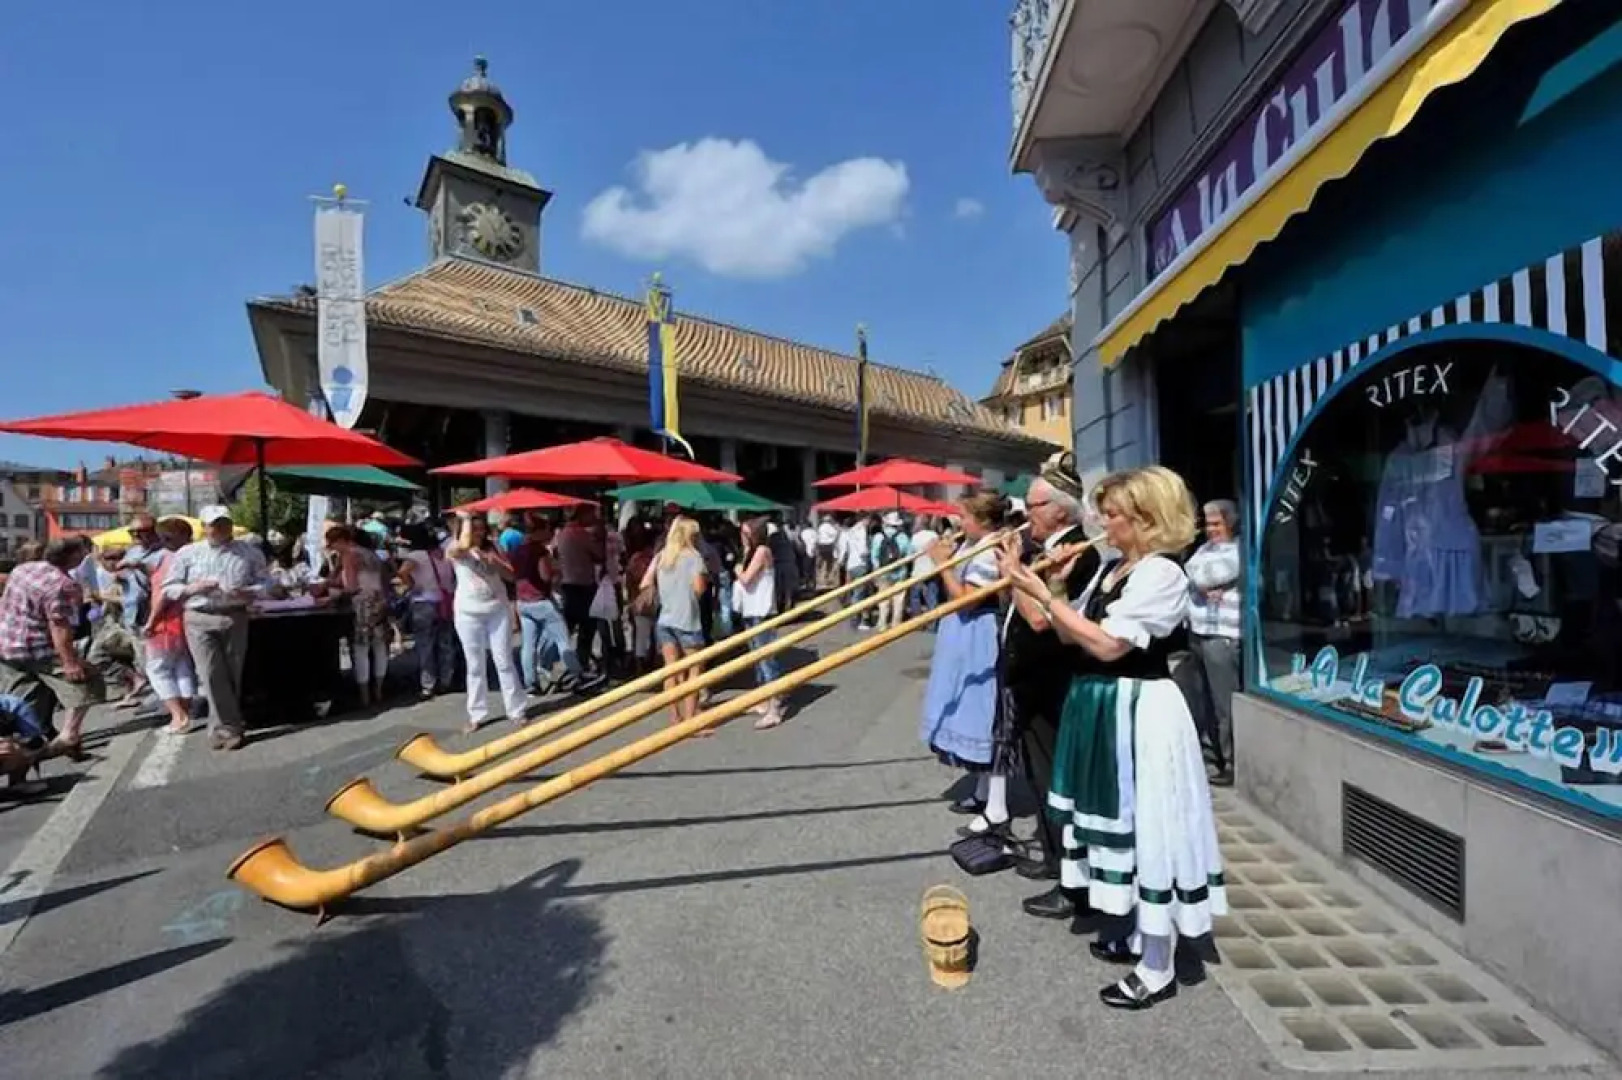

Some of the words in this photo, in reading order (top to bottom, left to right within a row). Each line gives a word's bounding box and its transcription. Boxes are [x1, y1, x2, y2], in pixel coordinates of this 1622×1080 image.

[1365, 362, 1453, 408] RITEX
[1550, 386, 1622, 486] RITE
[1275, 448, 1318, 523] RITEX
[1351, 652, 1385, 708] la
